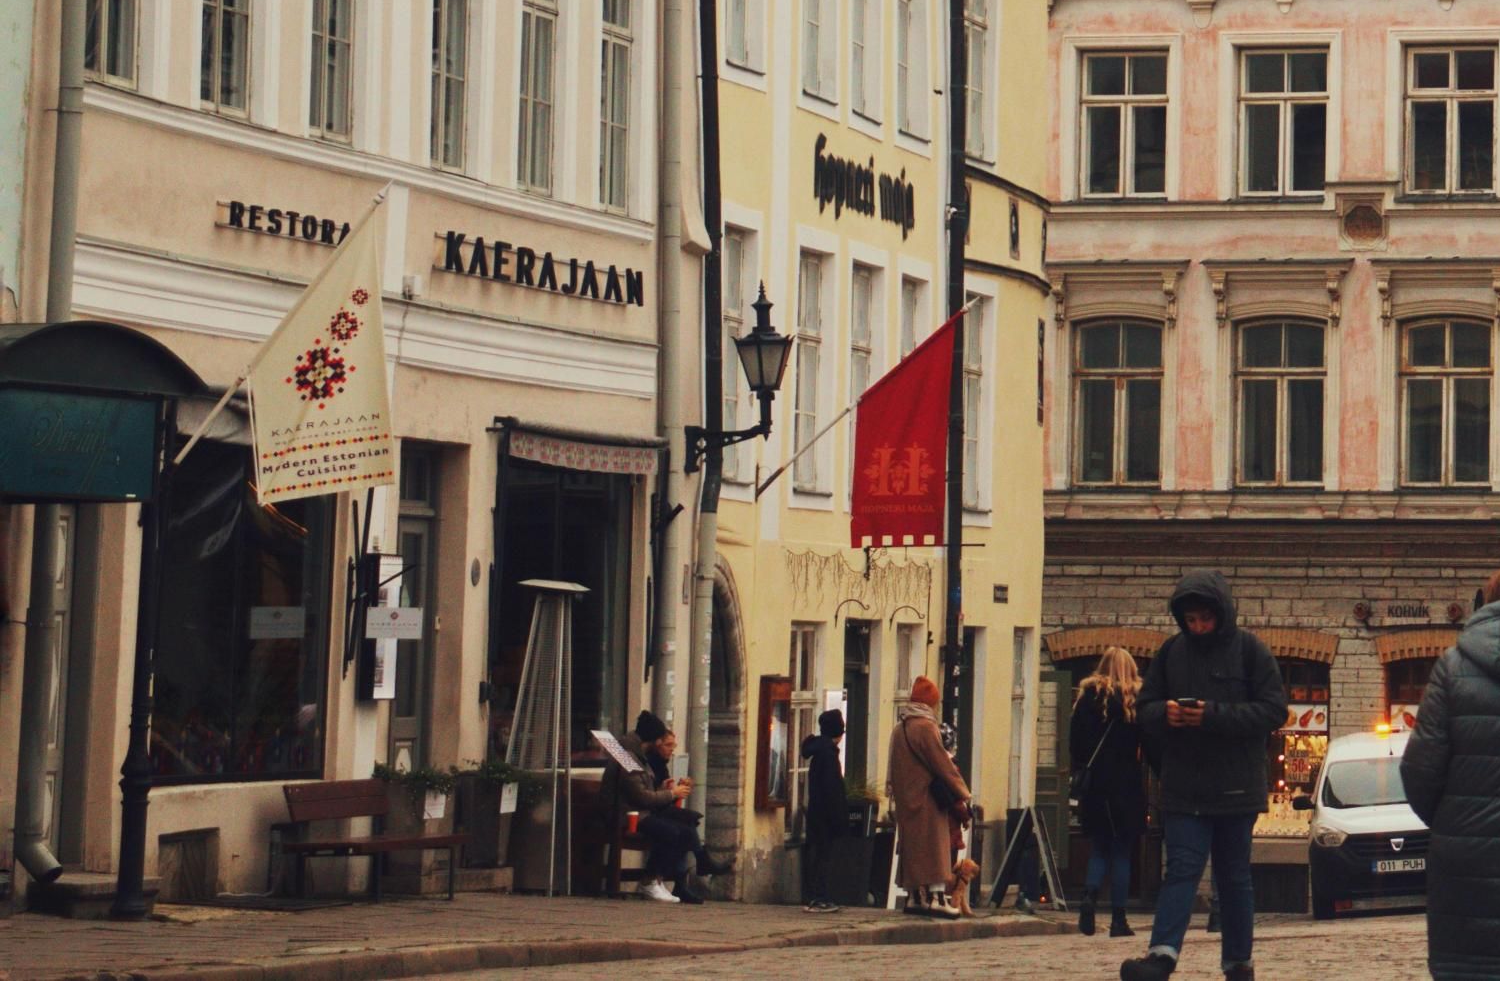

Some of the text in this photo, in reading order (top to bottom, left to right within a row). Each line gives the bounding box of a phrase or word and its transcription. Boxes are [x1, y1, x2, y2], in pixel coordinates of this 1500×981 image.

[445, 230, 644, 307] KAERAJAAN
[271, 413, 381, 437] KAERAJAAN
[323, 447, 390, 463] Estonian
[296, 463, 357, 478] Cuisine
[1387, 604, 1430, 618] KOHVIK
[1380, 859, 1424, 871] 011 PUH
